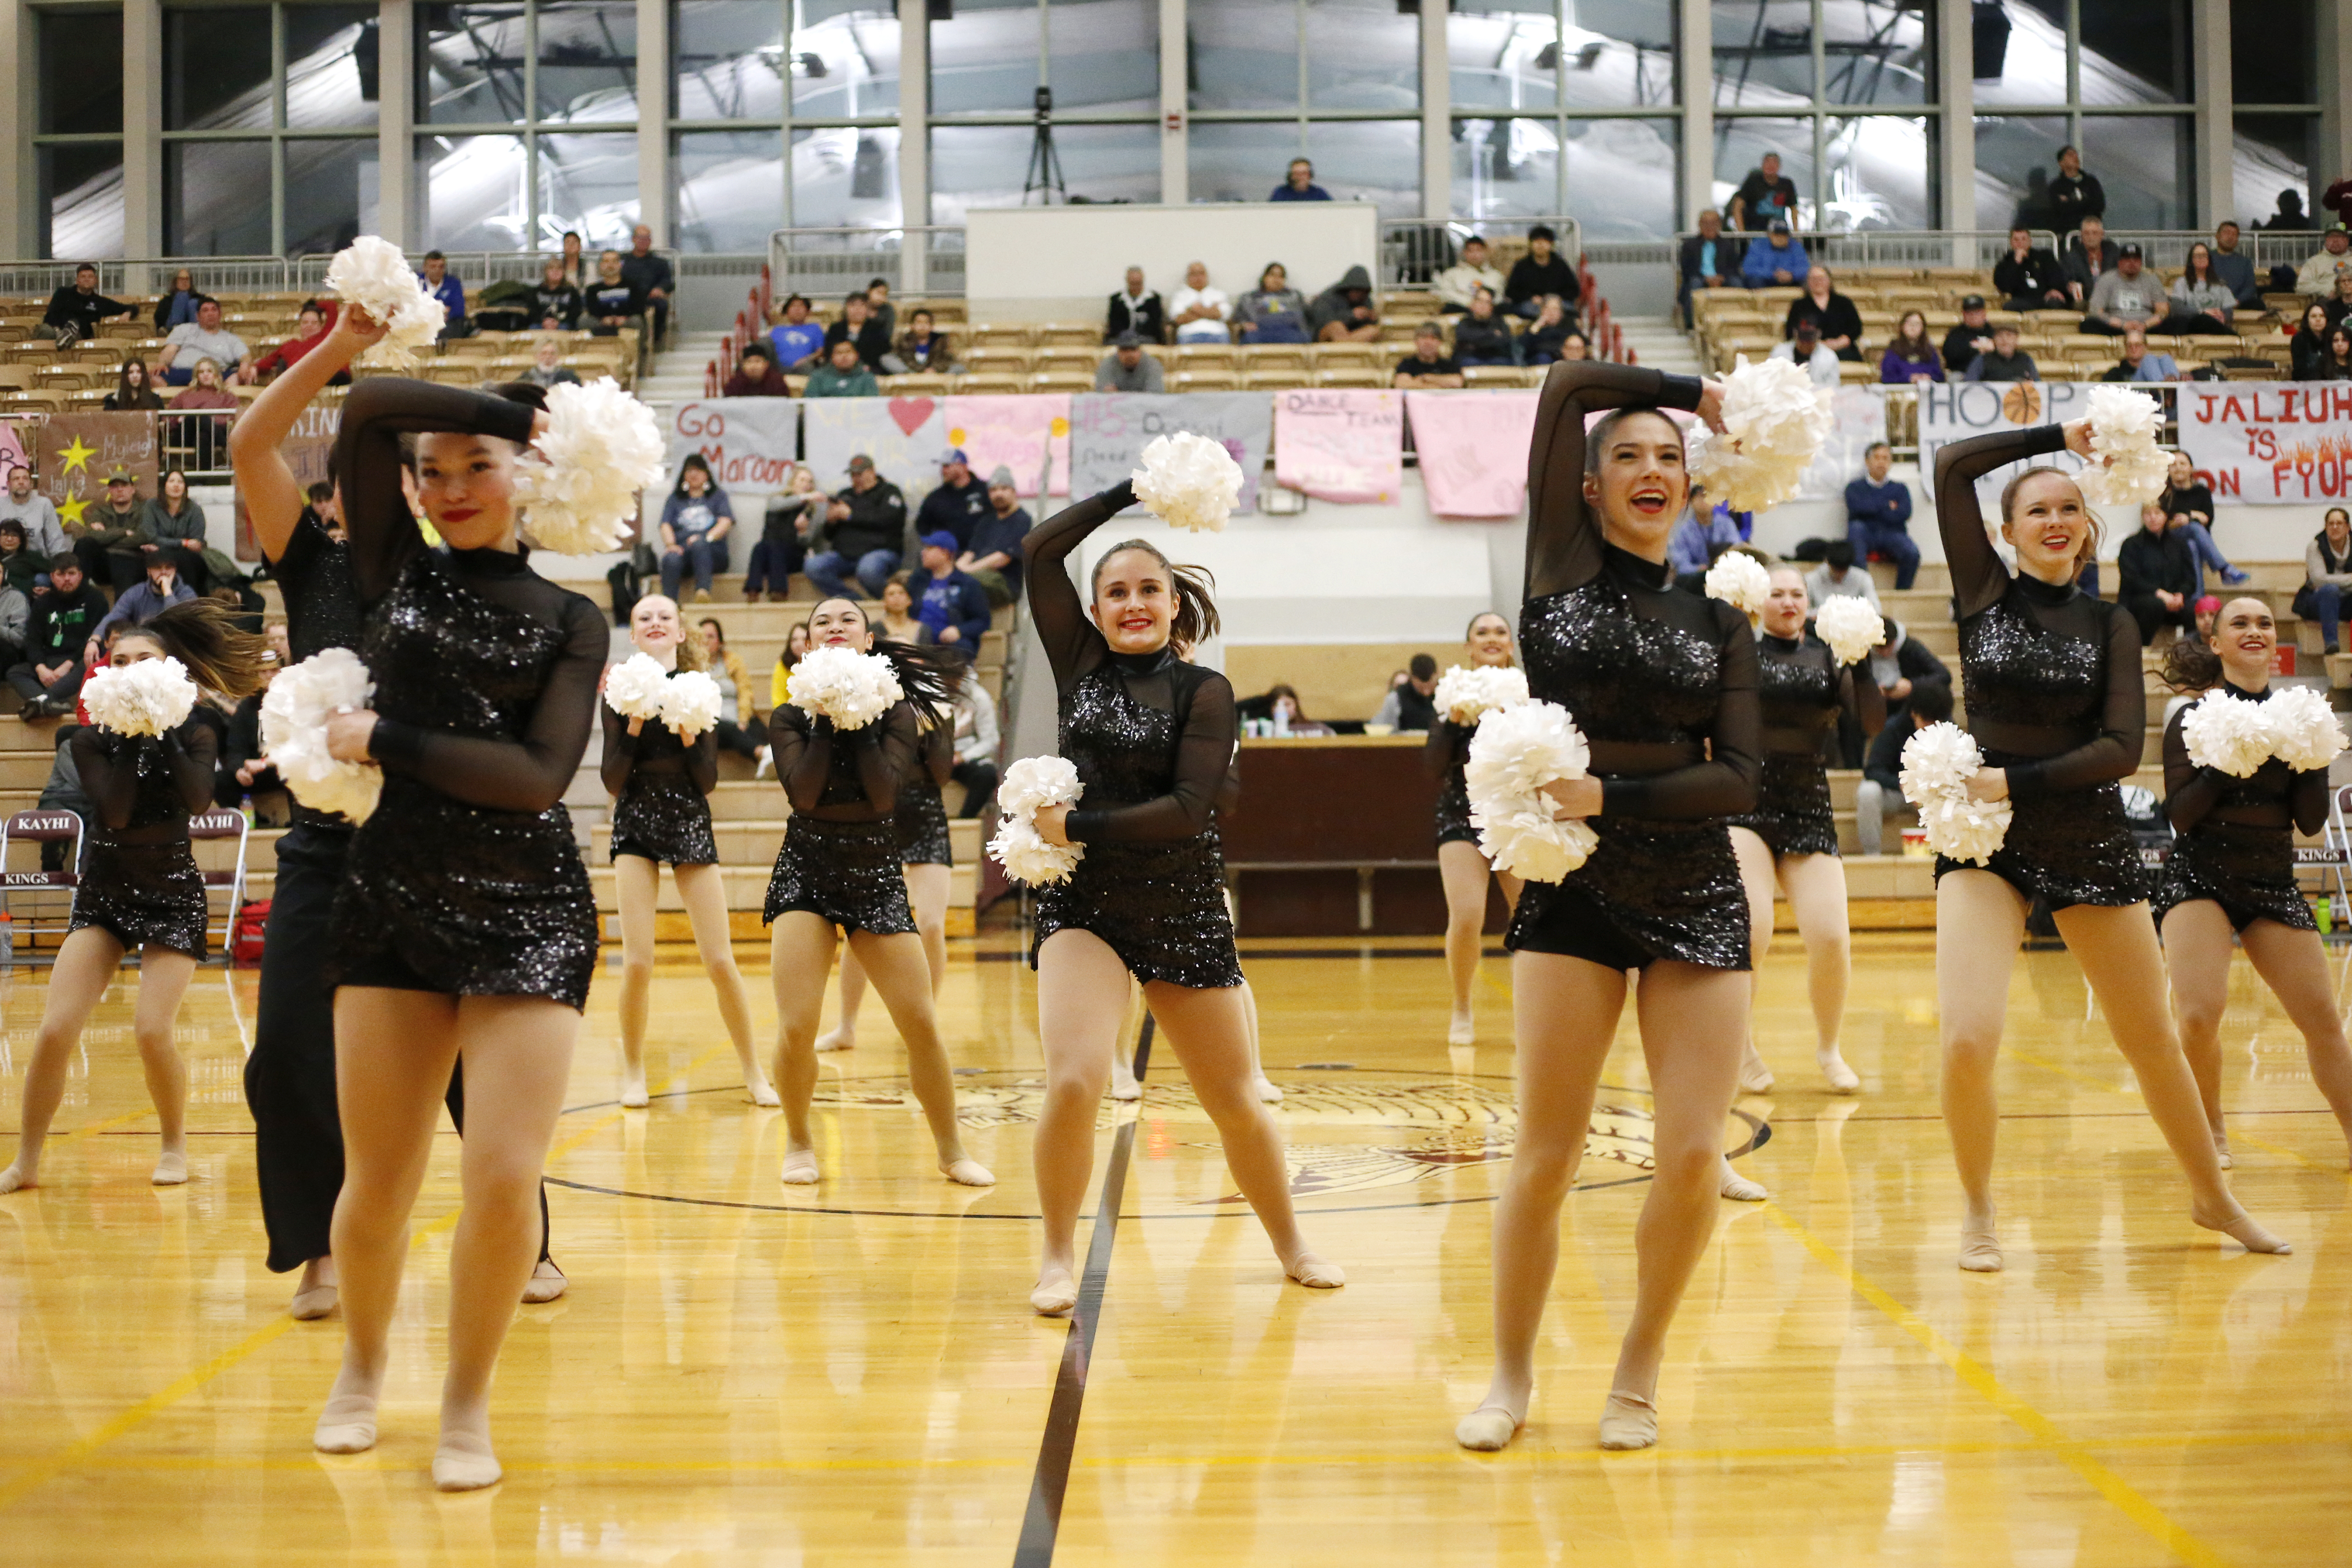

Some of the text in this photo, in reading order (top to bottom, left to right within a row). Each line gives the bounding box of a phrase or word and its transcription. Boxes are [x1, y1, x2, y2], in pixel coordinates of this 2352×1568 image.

[2196, 387, 2352, 423] JALIUH
[18, 817, 70, 830] KAYHI
[2298, 849, 2341, 862] KINGS
[5, 873, 49, 884] KINGS
